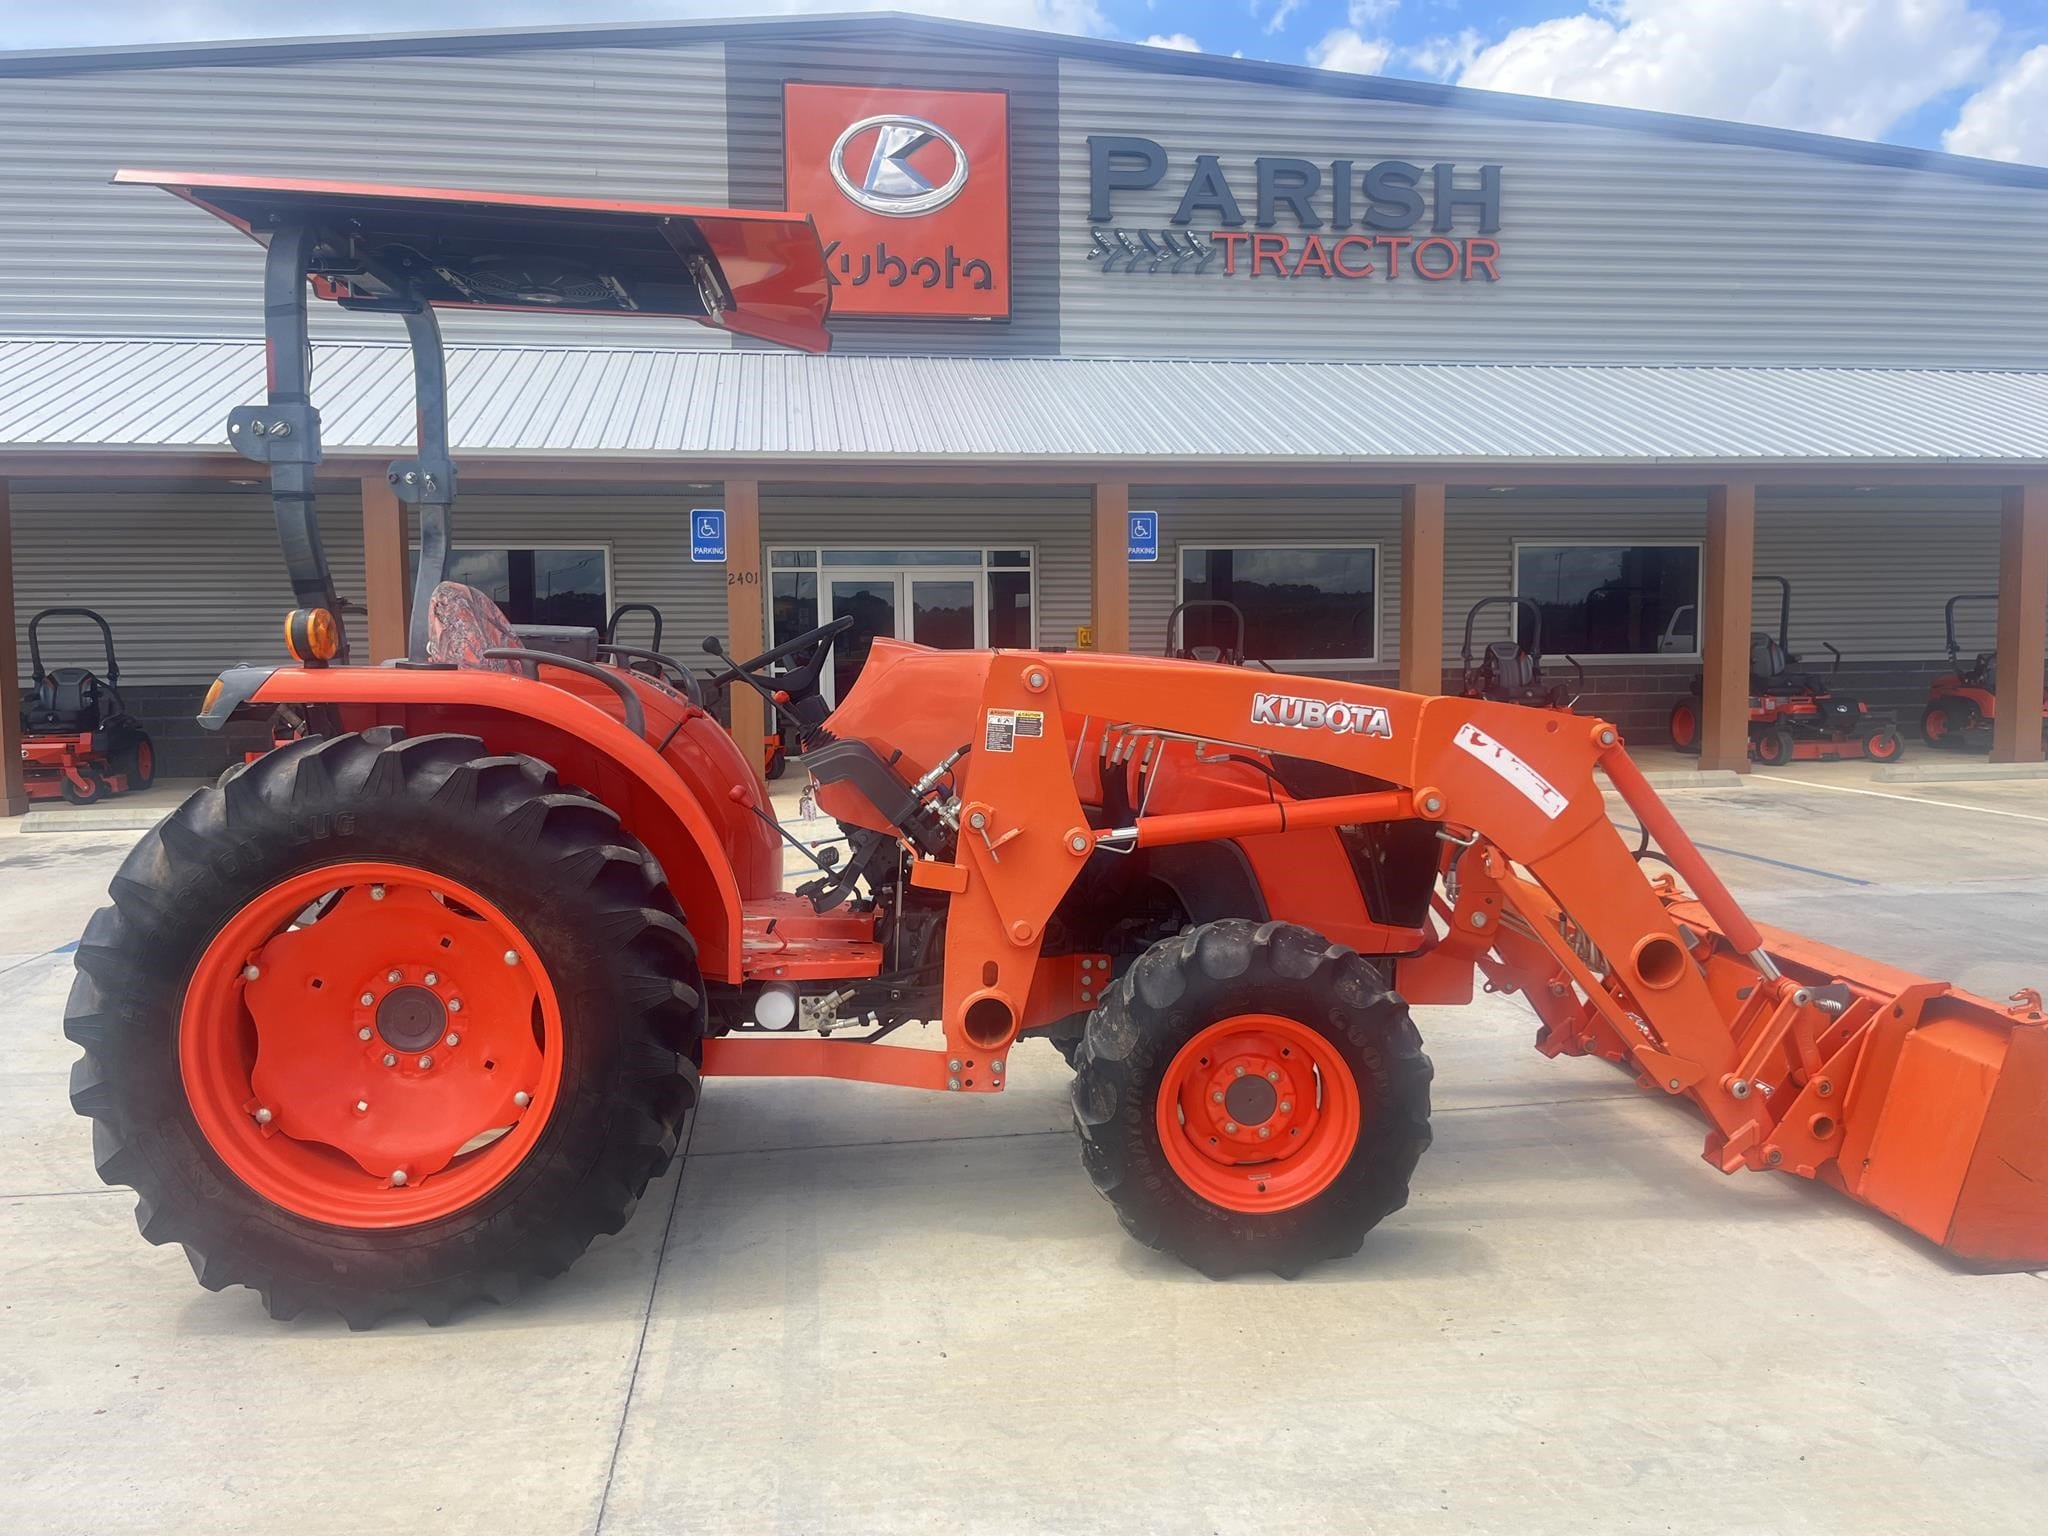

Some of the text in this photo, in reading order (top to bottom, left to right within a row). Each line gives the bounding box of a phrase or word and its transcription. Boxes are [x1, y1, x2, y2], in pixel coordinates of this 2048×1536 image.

[1087, 135, 1503, 234] PARISH
[1210, 230, 1501, 282] TRACTOR
[694, 546, 724, 555] PARKING
[728, 571, 758, 586] 2401
[1252, 693, 1391, 738] KUBOTA
[290, 811, 357, 846] LUG
